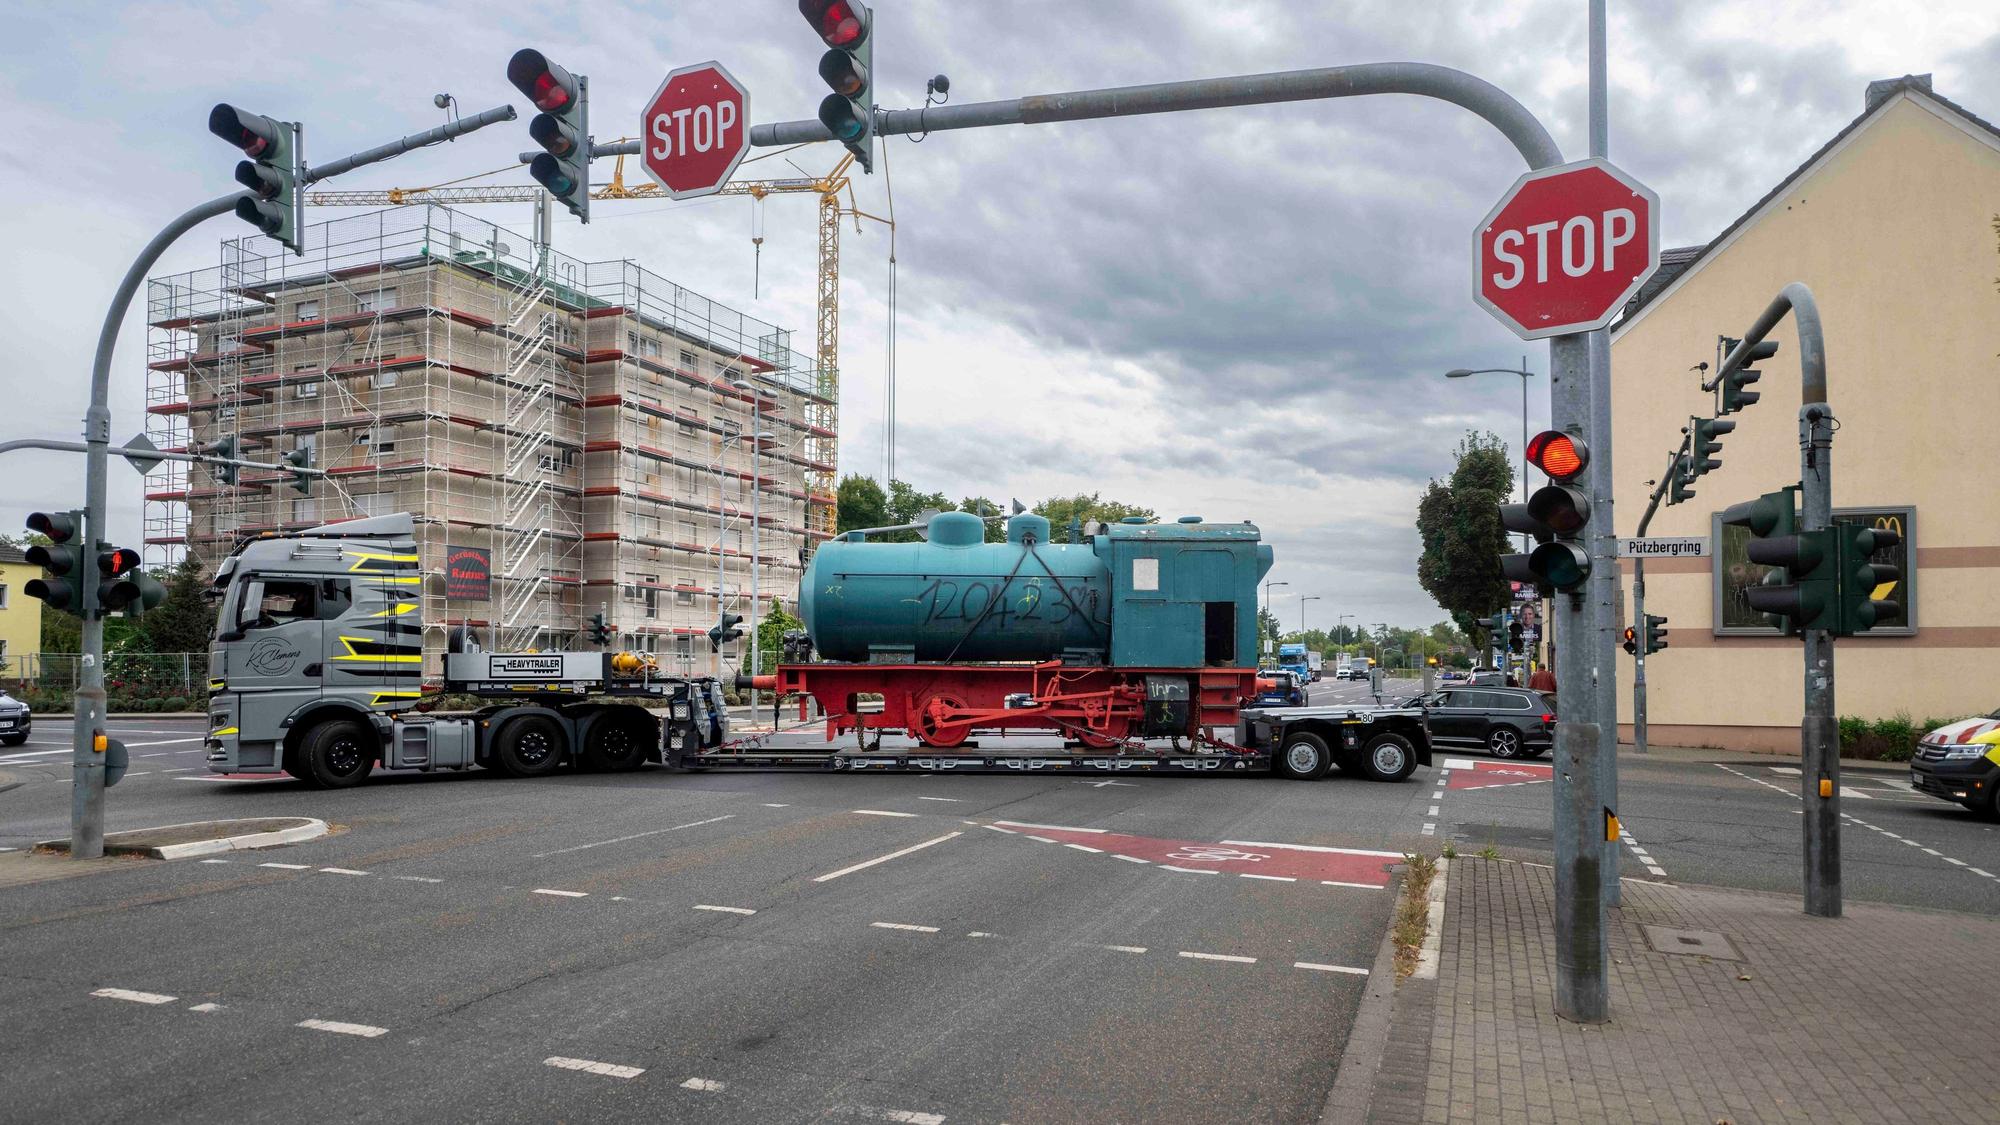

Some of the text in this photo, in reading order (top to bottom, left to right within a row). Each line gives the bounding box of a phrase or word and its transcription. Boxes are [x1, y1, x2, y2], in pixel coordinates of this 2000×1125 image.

[652, 100, 736, 161] STOP
[1493, 207, 1636, 290] STOP
[1629, 539, 1701, 556] Pützbergring
[507, 659, 560, 669] HEAVYTRAILER
[1362, 713, 1373, 723] 80
